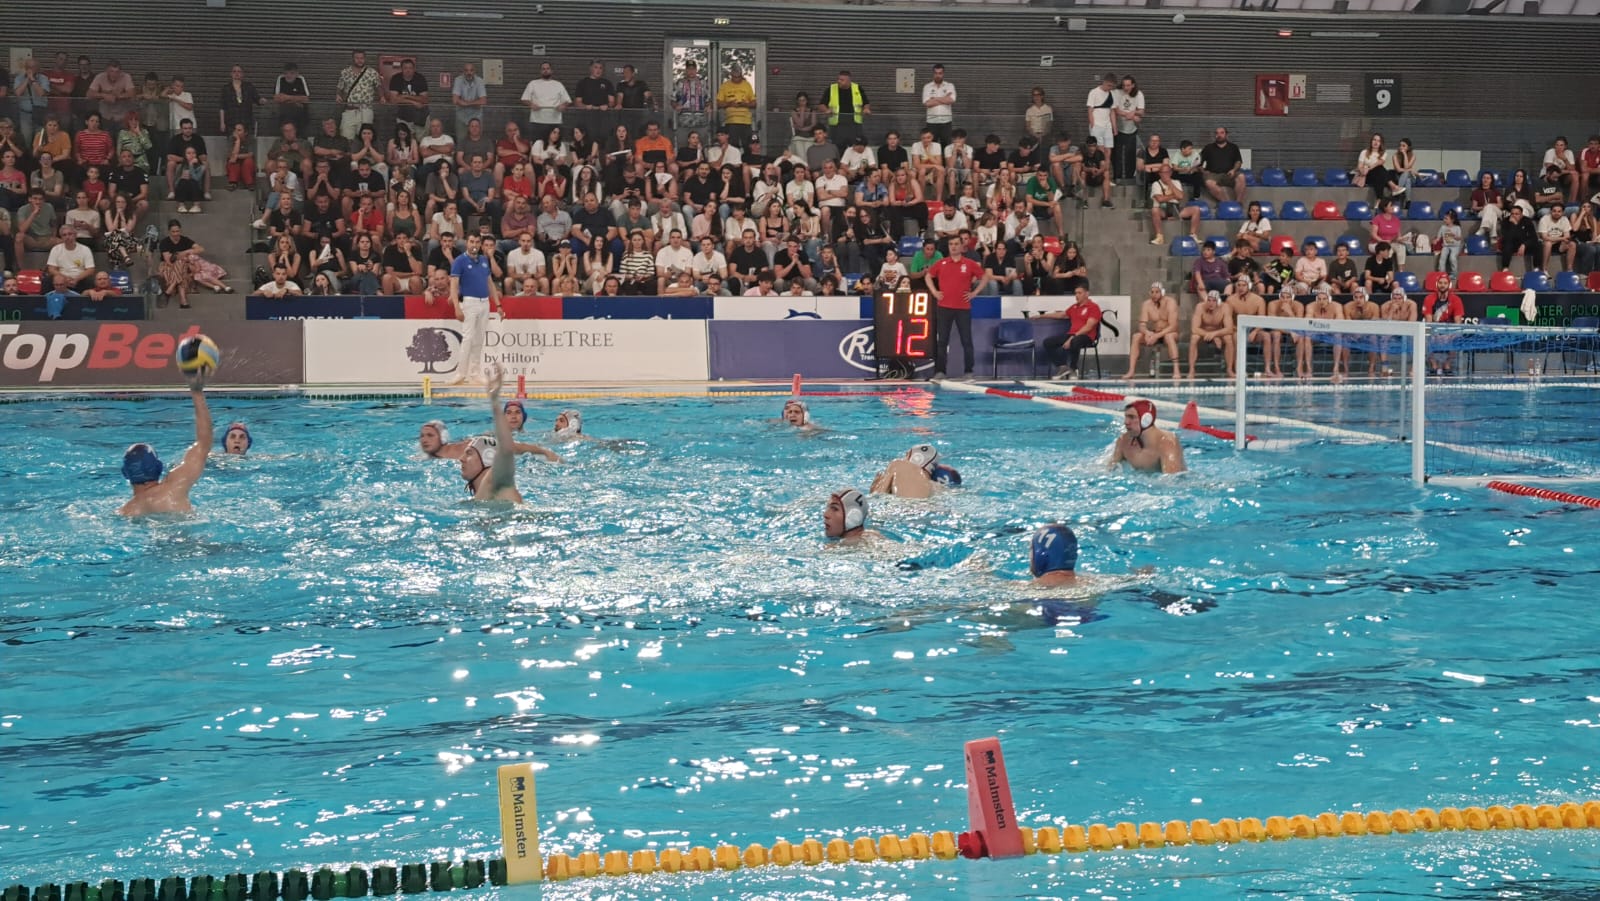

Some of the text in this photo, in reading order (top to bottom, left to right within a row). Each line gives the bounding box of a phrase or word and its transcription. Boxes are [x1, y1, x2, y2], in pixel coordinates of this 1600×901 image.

[1376, 89, 1391, 109] 9
[882, 293, 928, 315] 7 18
[1535, 304, 1598, 316] ATER POLO
[896, 318, 929, 356] 12
[0, 324, 201, 381] opBe
[484, 352, 541, 364] by Hilton
[1038, 529, 1057, 549] 11
[985, 766, 1006, 829] Malmsten
[512, 793, 527, 859] Malmsten
